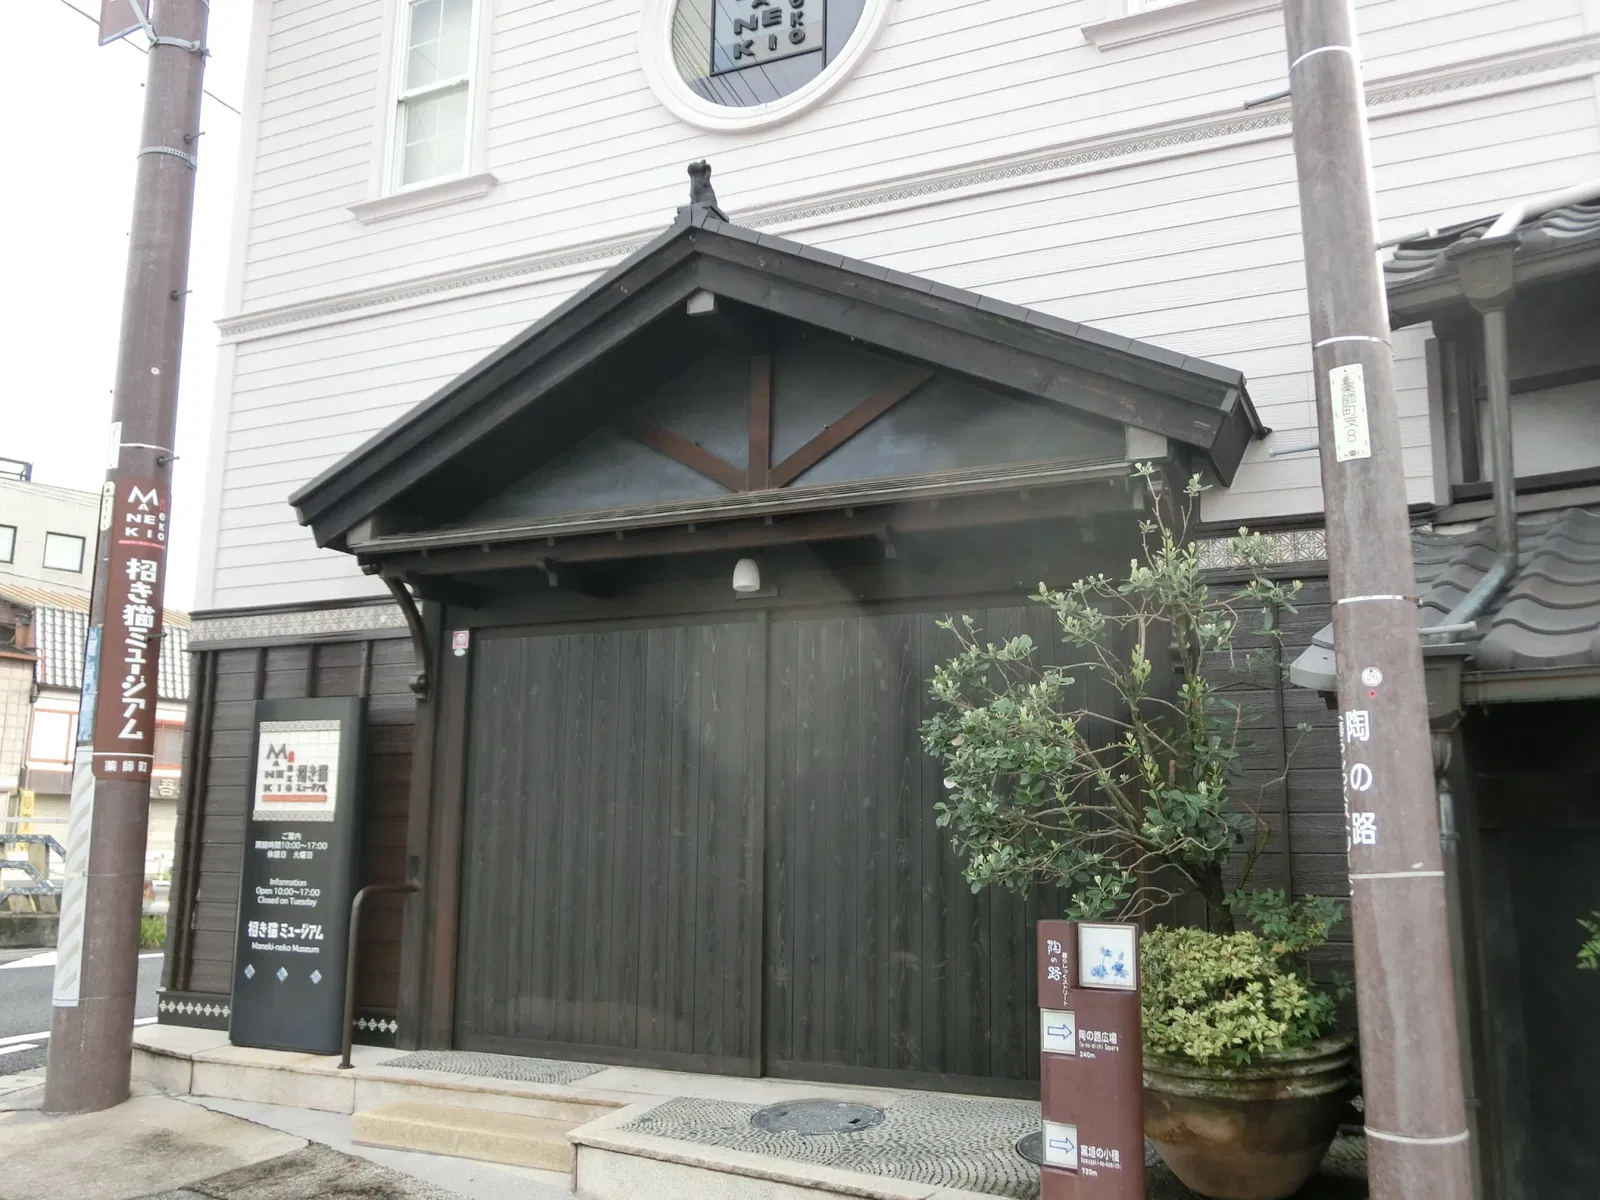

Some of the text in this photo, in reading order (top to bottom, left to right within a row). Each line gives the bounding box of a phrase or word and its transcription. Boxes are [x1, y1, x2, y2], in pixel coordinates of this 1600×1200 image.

[117, 557, 158, 740] 招き猫ミュージアム
[1345, 708, 1377, 845] 陶の路
[269, 877, 308, 887] Information
[255, 886, 273, 896] Open
[257, 895, 280, 904] Closed
[289, 897, 318, 908] Tuesday
[292, 943, 320, 954] Museum
